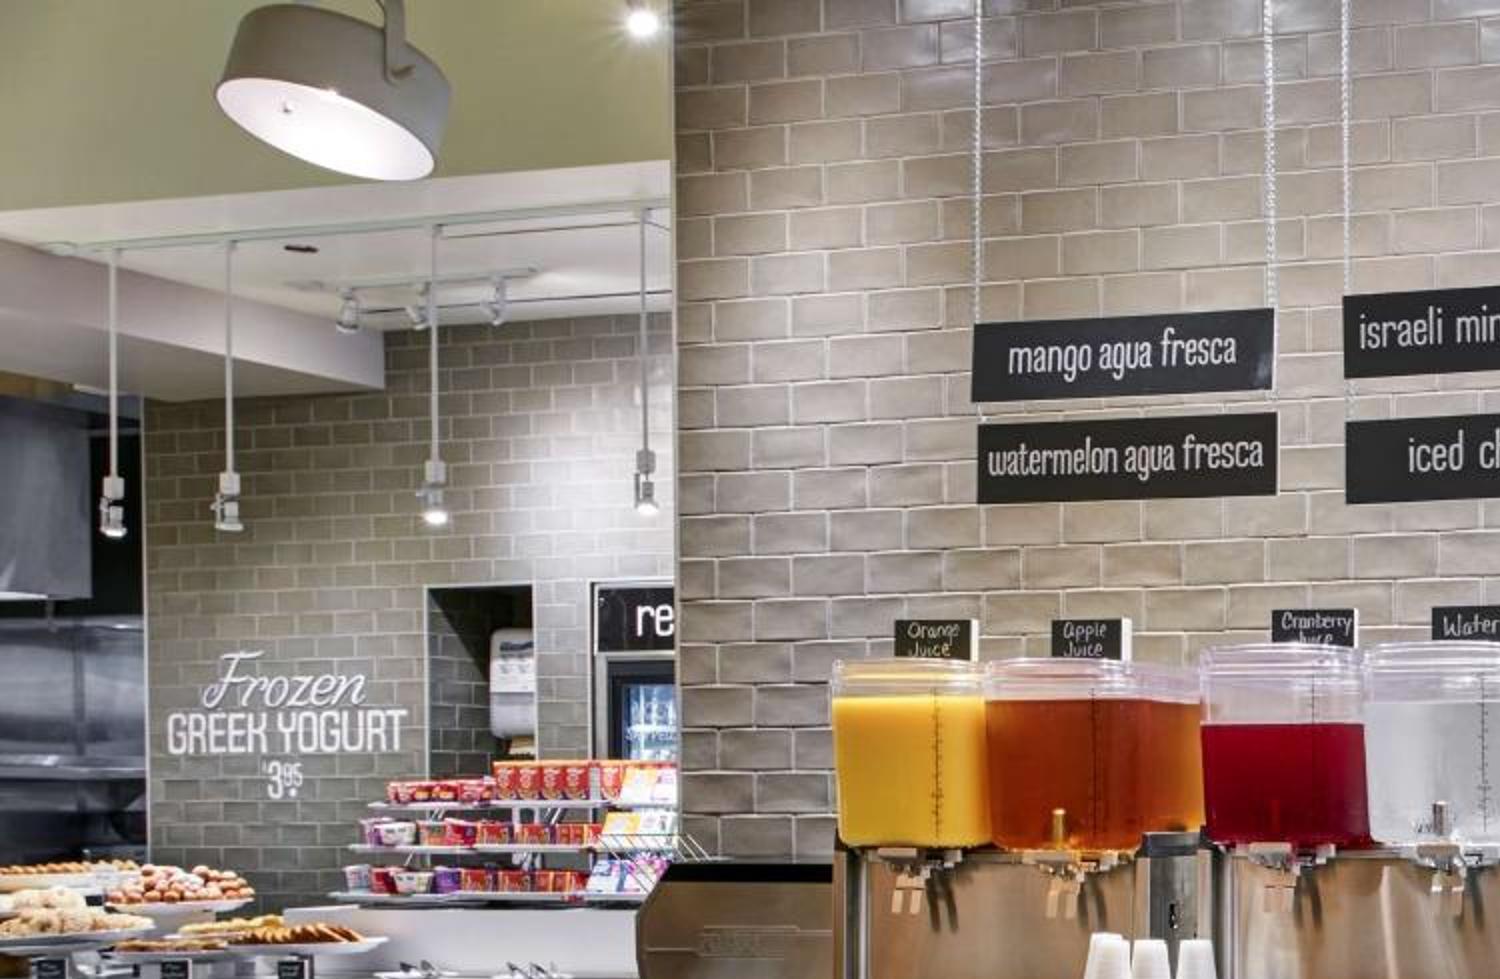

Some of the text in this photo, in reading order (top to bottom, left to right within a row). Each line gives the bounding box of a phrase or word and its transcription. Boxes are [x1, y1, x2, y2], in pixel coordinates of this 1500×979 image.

[1359, 305, 1443, 350] israeli
[1008, 326, 1237, 383] mango agua fresca
[987, 433, 1264, 482] watermelon agua fresca
[1408, 429, 1464, 473] iced
[906, 621, 960, 647] Orange
[1281, 611, 1352, 637] Cranberry
[907, 641, 952, 657] Juice
[1062, 640, 1104, 657] Juice
[202, 650, 367, 708] Frozen
[166, 708, 409, 755] GREEK YOGURT
